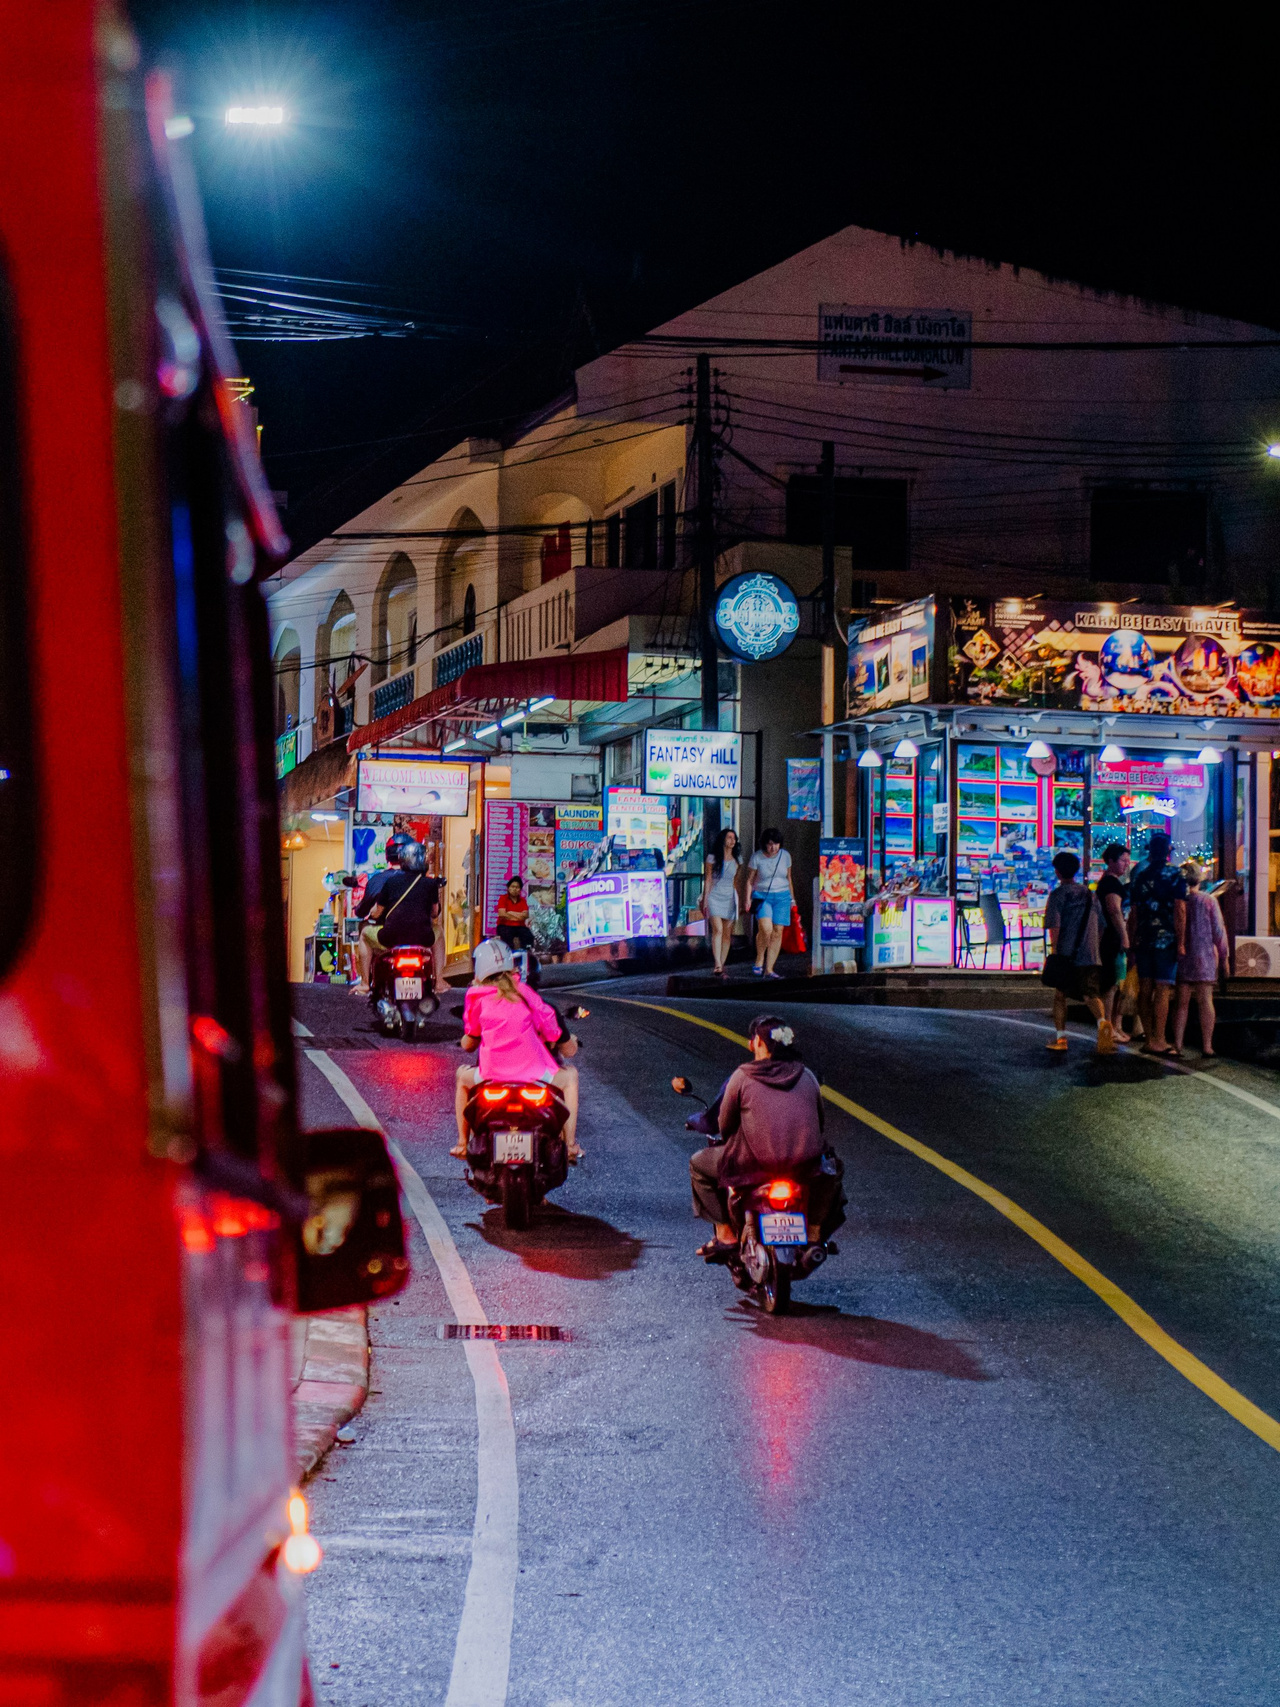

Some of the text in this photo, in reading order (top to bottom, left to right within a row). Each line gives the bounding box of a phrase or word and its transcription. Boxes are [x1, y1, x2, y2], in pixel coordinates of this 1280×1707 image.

[1075, 612, 1119, 628] KARN
[1121, 614, 1142, 630] BE
[1144, 615, 1182, 631] EASY
[1183, 617, 1241, 633] TRAVEL
[649, 746, 738, 765] FANTASY HILL
[362, 768, 467, 786] WELCOME MASSAGE
[673, 774, 738, 789] BUNGALOW
[1101, 771, 1203, 786] KARN BE EASY TRAVEL
[617, 796, 660, 804] FANTASY
[558, 809, 601, 819] LAUNDRY
[560, 820, 599, 830] SERVICE
[560, 840, 595, 850] 80/KG
